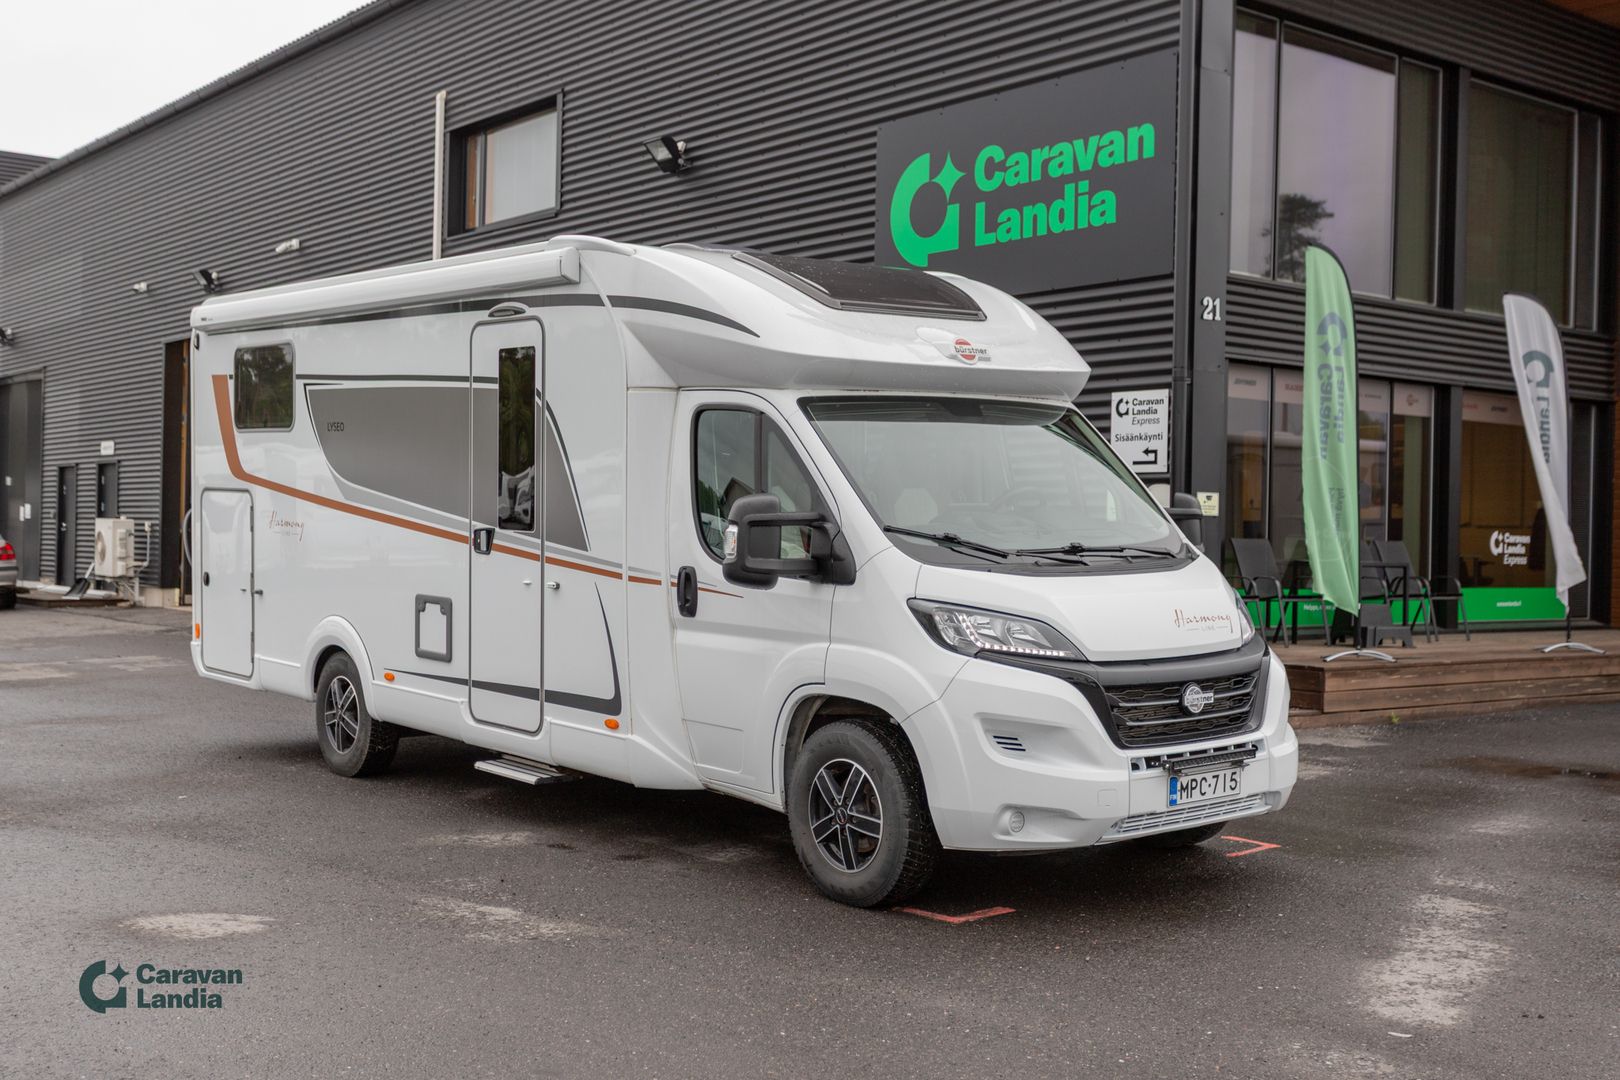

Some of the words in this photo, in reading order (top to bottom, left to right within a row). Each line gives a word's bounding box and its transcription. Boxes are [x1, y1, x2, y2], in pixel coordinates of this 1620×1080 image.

[974, 122, 1155, 192] Caravan
[974, 180, 1117, 247] Landia
[1202, 296, 1221, 321] 21
[1132, 397, 1164, 406] Caravan
[1132, 407, 1158, 416] Landia
[1131, 417, 1160, 425] Express
[327, 422, 344, 432] LYSEO
[1115, 432, 1163, 442] Sisäänkäynti
[1504, 532, 1531, 543] Caravan
[1504, 543, 1526, 554] Landia
[1503, 554, 1528, 567] Express
[1174, 609, 1233, 634] Harmony
